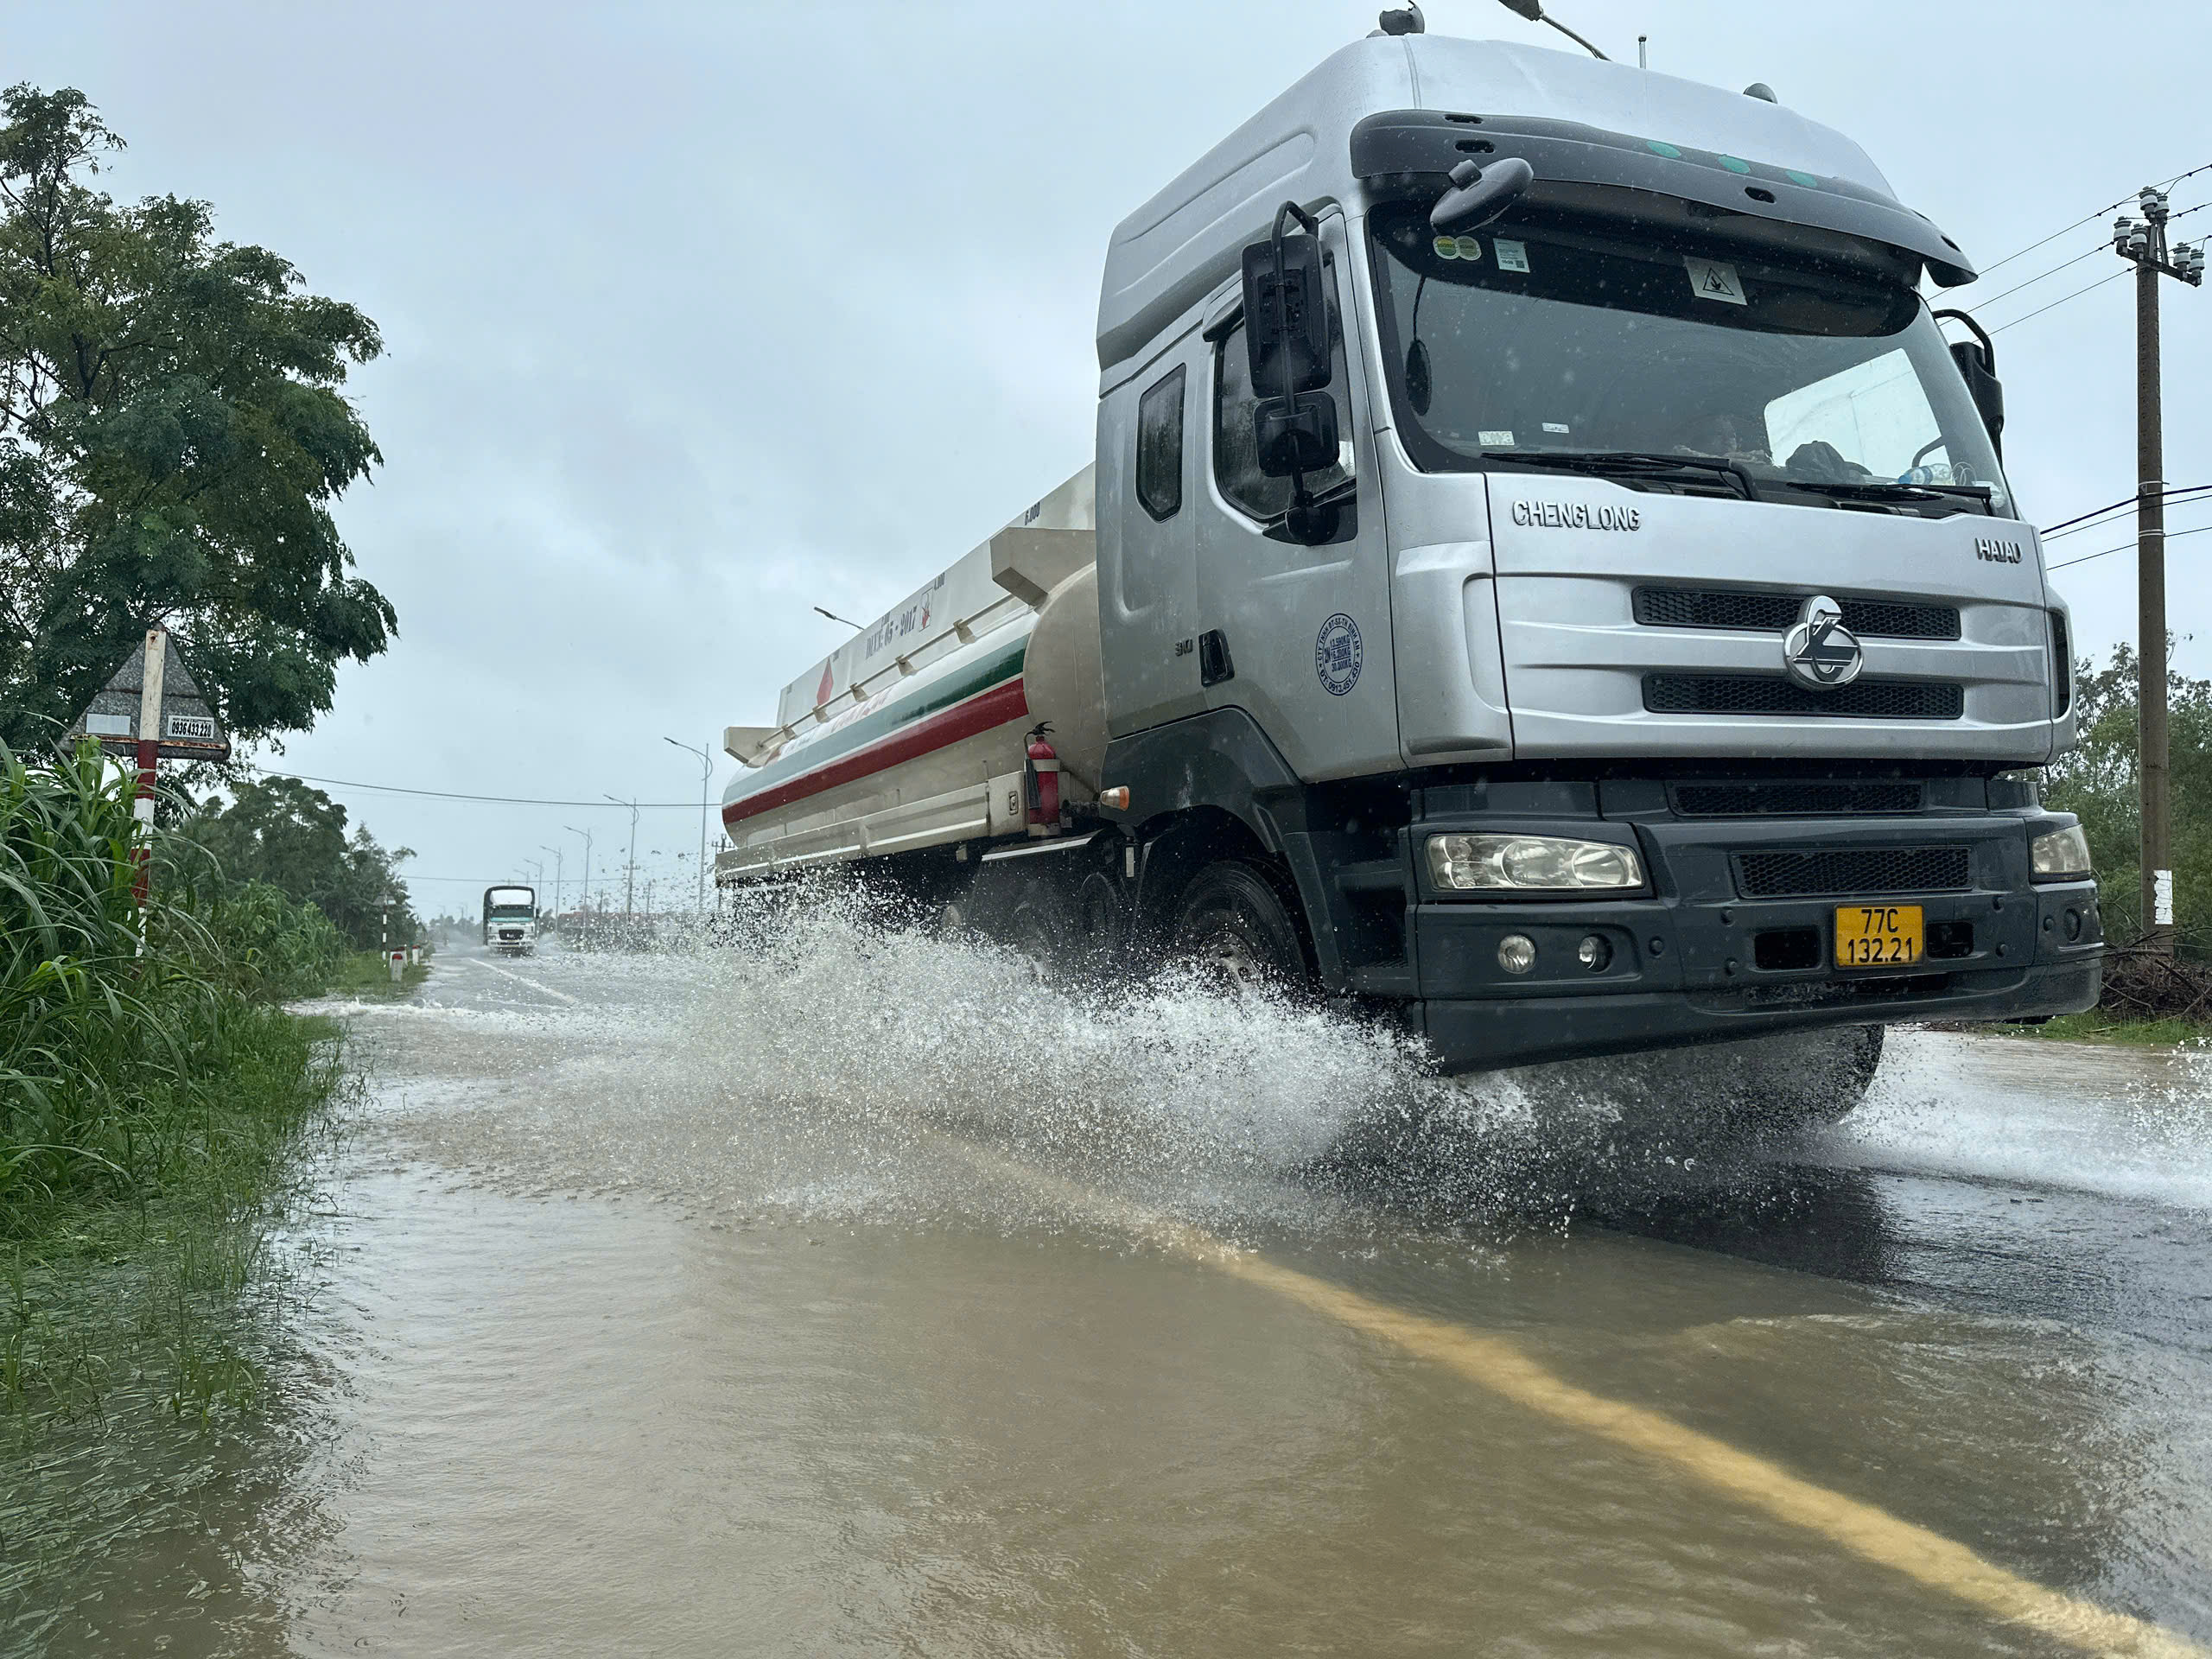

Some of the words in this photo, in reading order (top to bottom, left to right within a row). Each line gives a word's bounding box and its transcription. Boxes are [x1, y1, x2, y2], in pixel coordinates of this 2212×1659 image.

[1512, 499, 1642, 531] CHENGLONG
[899, 605, 917, 636] 2017
[1861, 908, 1898, 933] 77C
[1847, 937, 1912, 963] 132.21
